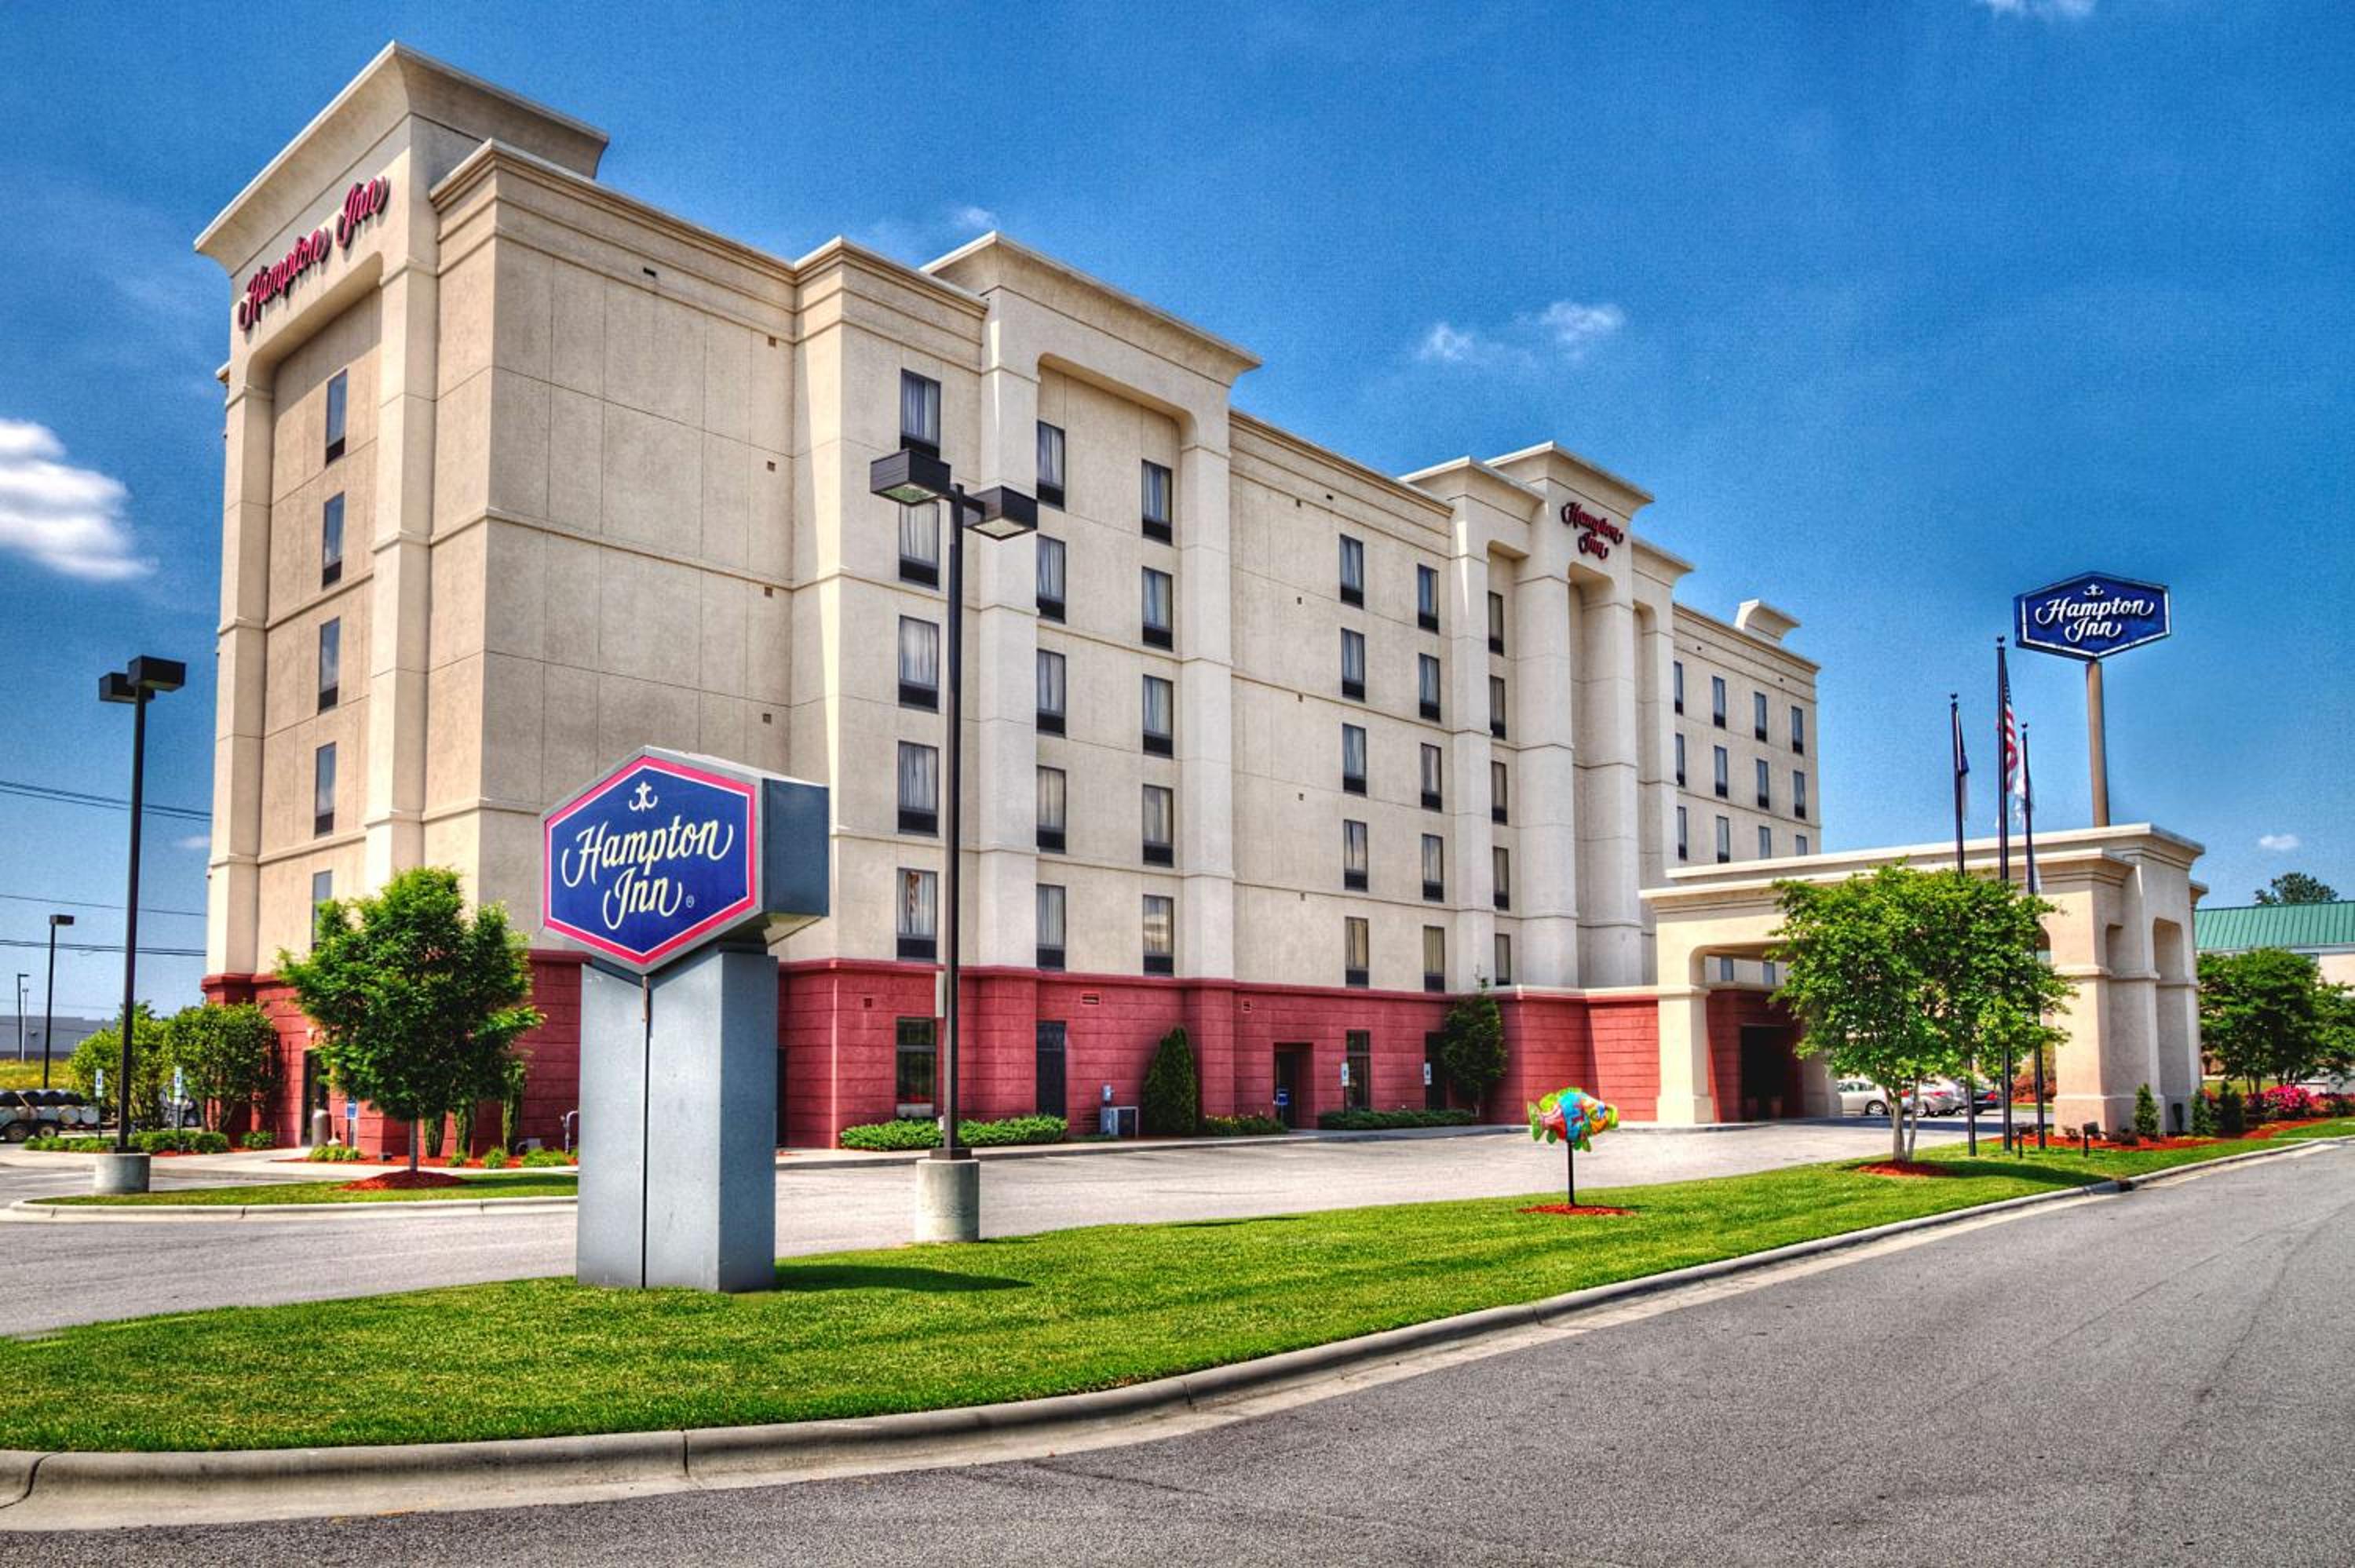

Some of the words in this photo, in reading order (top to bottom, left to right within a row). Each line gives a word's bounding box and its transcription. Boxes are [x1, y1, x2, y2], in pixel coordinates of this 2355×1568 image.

[239, 224, 333, 330] Hampton
[336, 177, 390, 249] Inn
[1561, 502, 1623, 545] Hampton
[1578, 532, 1609, 560] Inn
[2035, 596, 2155, 625] Hampton
[2065, 616, 2122, 642] Inn
[561, 815, 734, 888] Hampton
[602, 867, 682, 929] Inn
